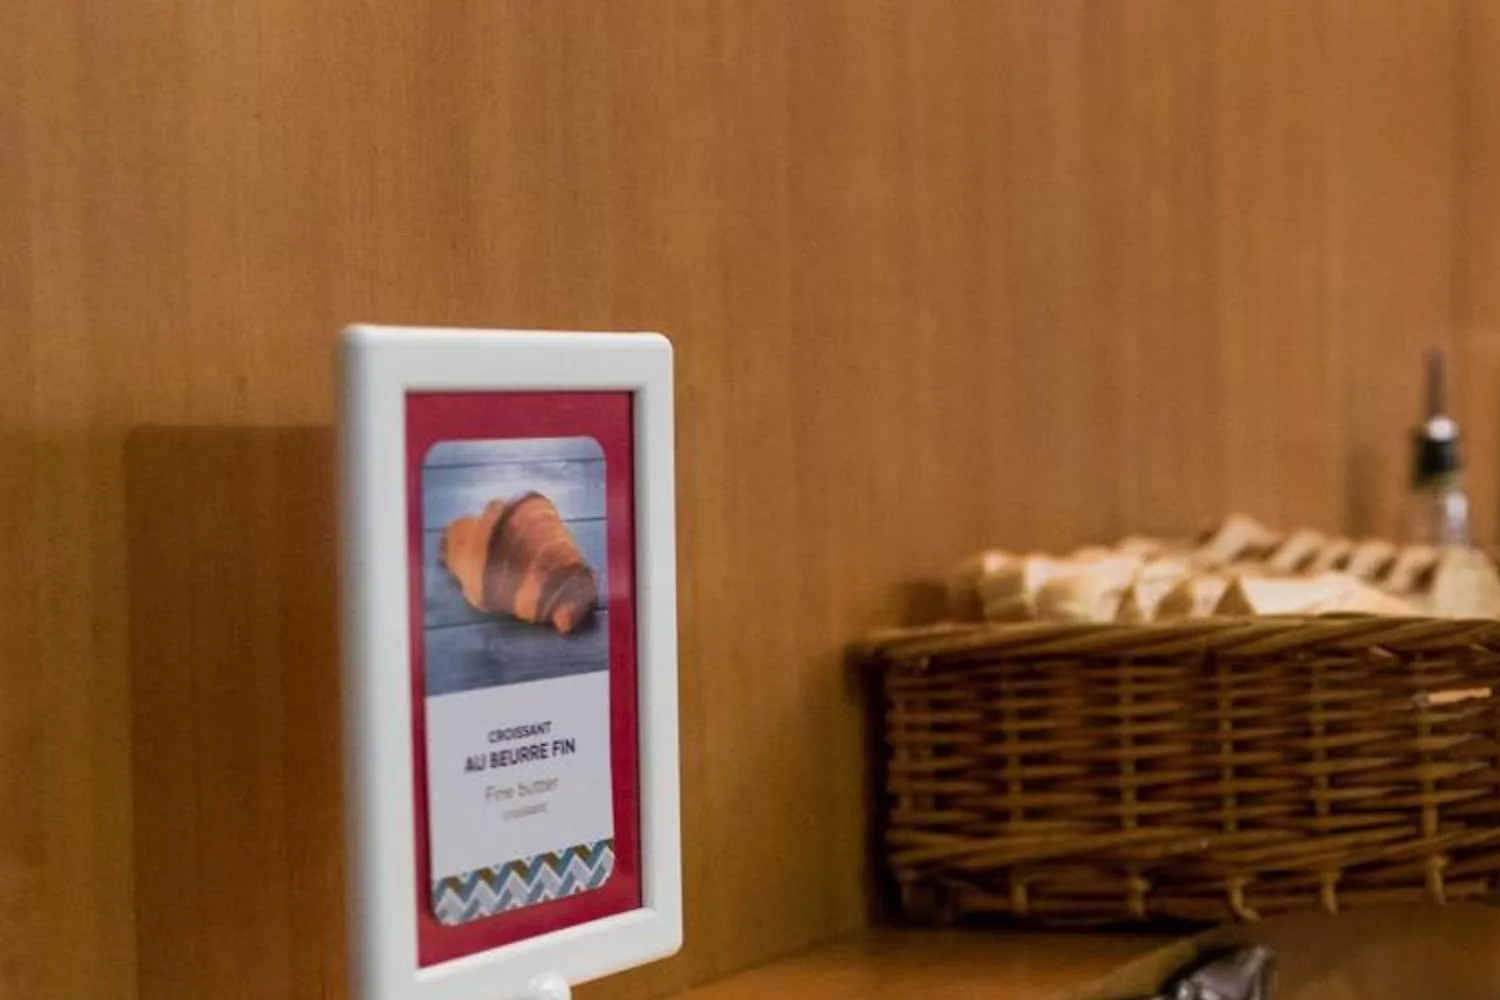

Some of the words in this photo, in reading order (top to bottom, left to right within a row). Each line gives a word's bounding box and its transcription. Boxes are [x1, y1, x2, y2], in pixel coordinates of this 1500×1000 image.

[488, 720, 552, 743] CROISSANT
[464, 753, 486, 773] AU
[489, 743, 549, 768] BEURRE
[552, 738, 576, 757] FIN
[486, 785, 515, 802] Fine
